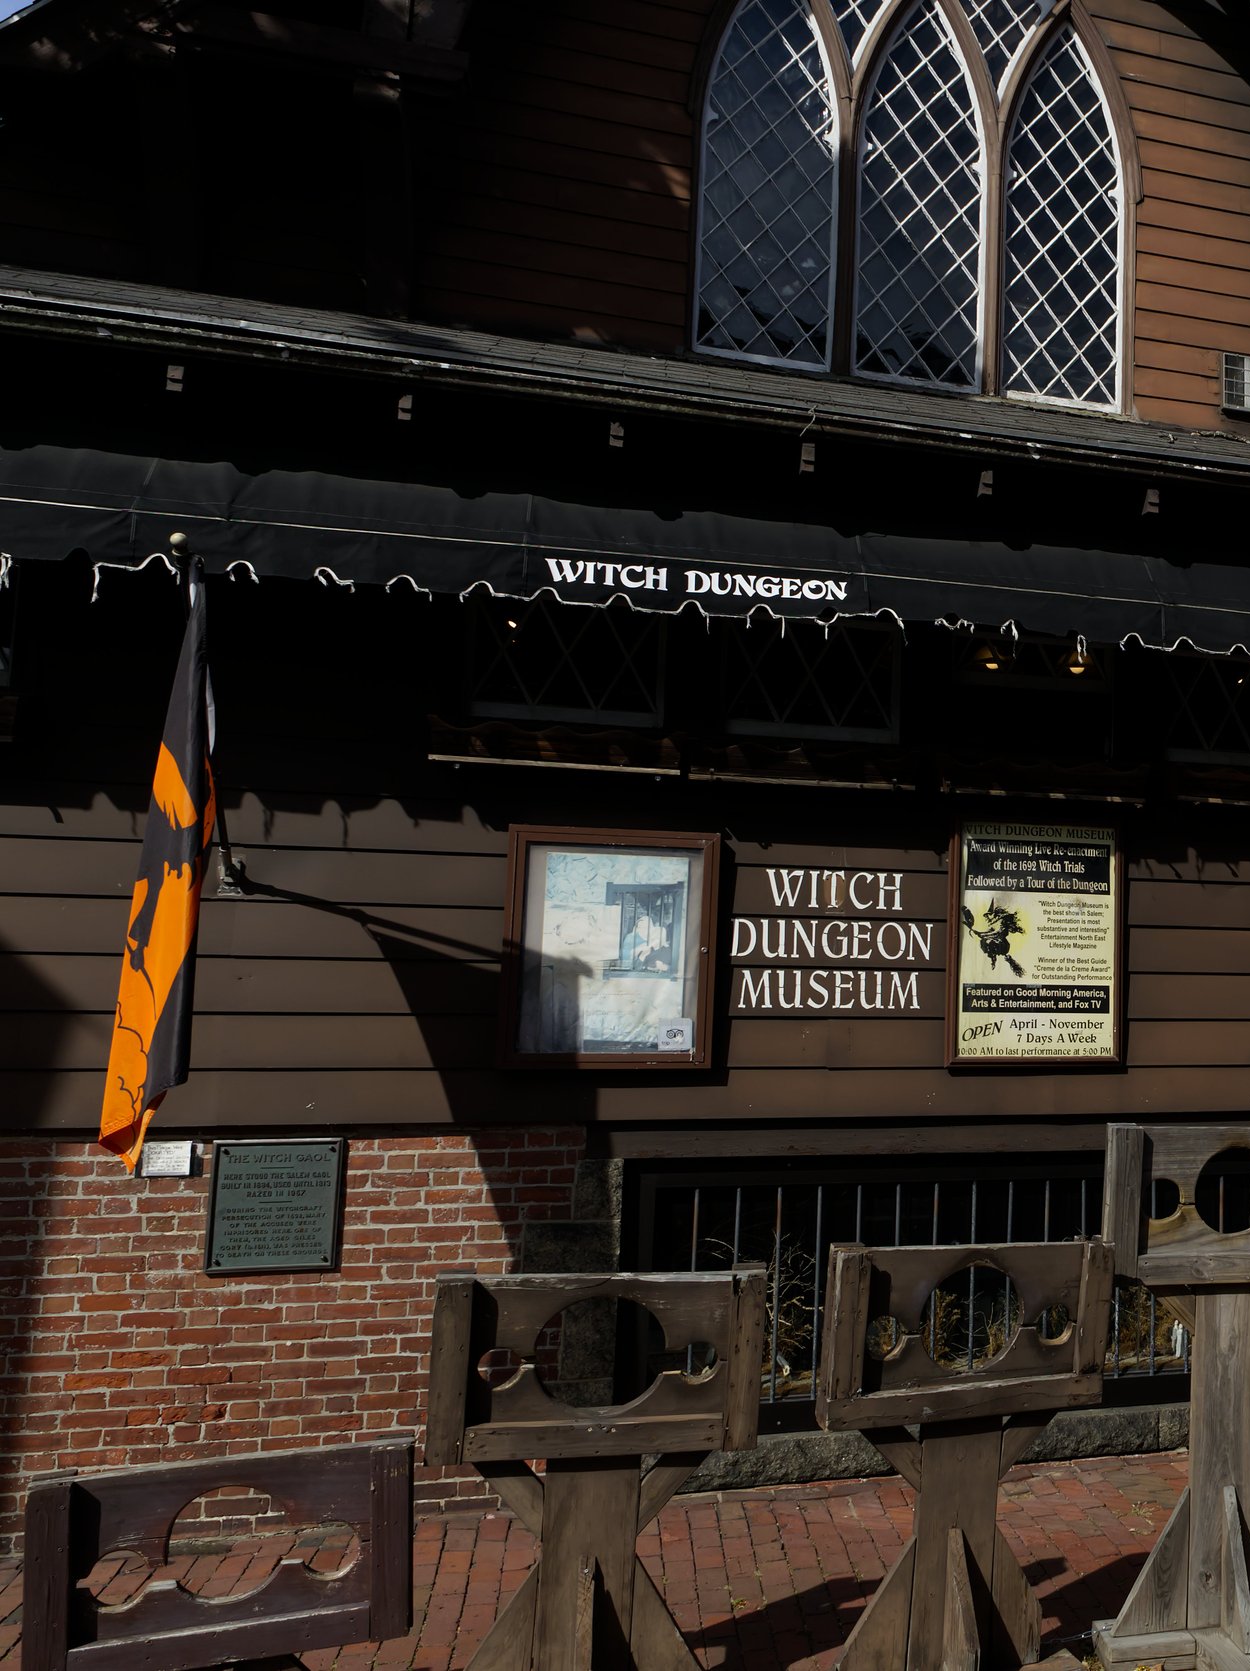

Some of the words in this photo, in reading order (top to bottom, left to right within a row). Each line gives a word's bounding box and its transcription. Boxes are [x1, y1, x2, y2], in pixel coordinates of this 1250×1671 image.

[545, 558, 668, 591] WITCH
[684, 570, 848, 600] DUNGEON
[1006, 826, 1063, 838] DUNGEON
[1066, 829, 1115, 841] MUSEUM
[970, 841, 996, 853] Award
[998, 842, 1033, 856] Winning
[1035, 844, 1052, 855] Live
[1053, 844, 1108, 858] Re-enactment
[993, 859, 1002, 870] of
[1004, 859, 1017, 870] the
[1019, 860, 1037, 872] 1692
[1039, 860, 1062, 872] Witch
[1063, 861, 1085, 873] Trials
[766, 869, 904, 910] WITCH
[968, 875, 1006, 887] Followed
[1007, 876, 1017, 890] by
[1019, 880, 1025, 888] a
[1027, 876, 1045, 888] Tour
[1047, 877, 1056, 888] of
[1057, 878, 1071, 889] the
[1072, 878, 1108, 893] Dungeon
[1057, 901, 1080, 909] Dungeon
[730, 918, 934, 961] DUNGEON
[1072, 942, 1097, 950] Magazine
[1041, 973, 1076, 981] Outstanding
[738, 970, 920, 1010] MUSEUM
[966, 987, 1001, 996] Featured
[1016, 988, 1038, 997] Good
[1039, 988, 1071, 999] Morning
[1073, 989, 1107, 999] America,
[971, 999, 989, 1008] Arts
[990, 999, 997, 1008] &
[999, 999, 1056, 1010] Entertainment,
[1058, 1000, 1073, 1009] and
[1074, 1000, 1089, 1009] Fox
[1091, 1000, 1101, 1009] TV
[962, 1020, 1003, 1042] OPEN
[1010, 1018, 1037, 1031] April
[1049, 1019, 1104, 1029] November
[1017, 1034, 1022, 1043] 7
[1026, 1033, 1053, 1045] Days
[1057, 1033, 1067, 1043] A
[1068, 1033, 1097, 1043] Week
[979, 1047, 993, 1055] AM
[996, 1047, 1004, 1055] to
[1005, 1047, 1019, 1055] last
[1021, 1047, 1071, 1057] performance
[227, 1154, 250, 1164] THE
[253, 1153, 291, 1163] WITCH
[296, 1153, 331, 1162] GAOL
